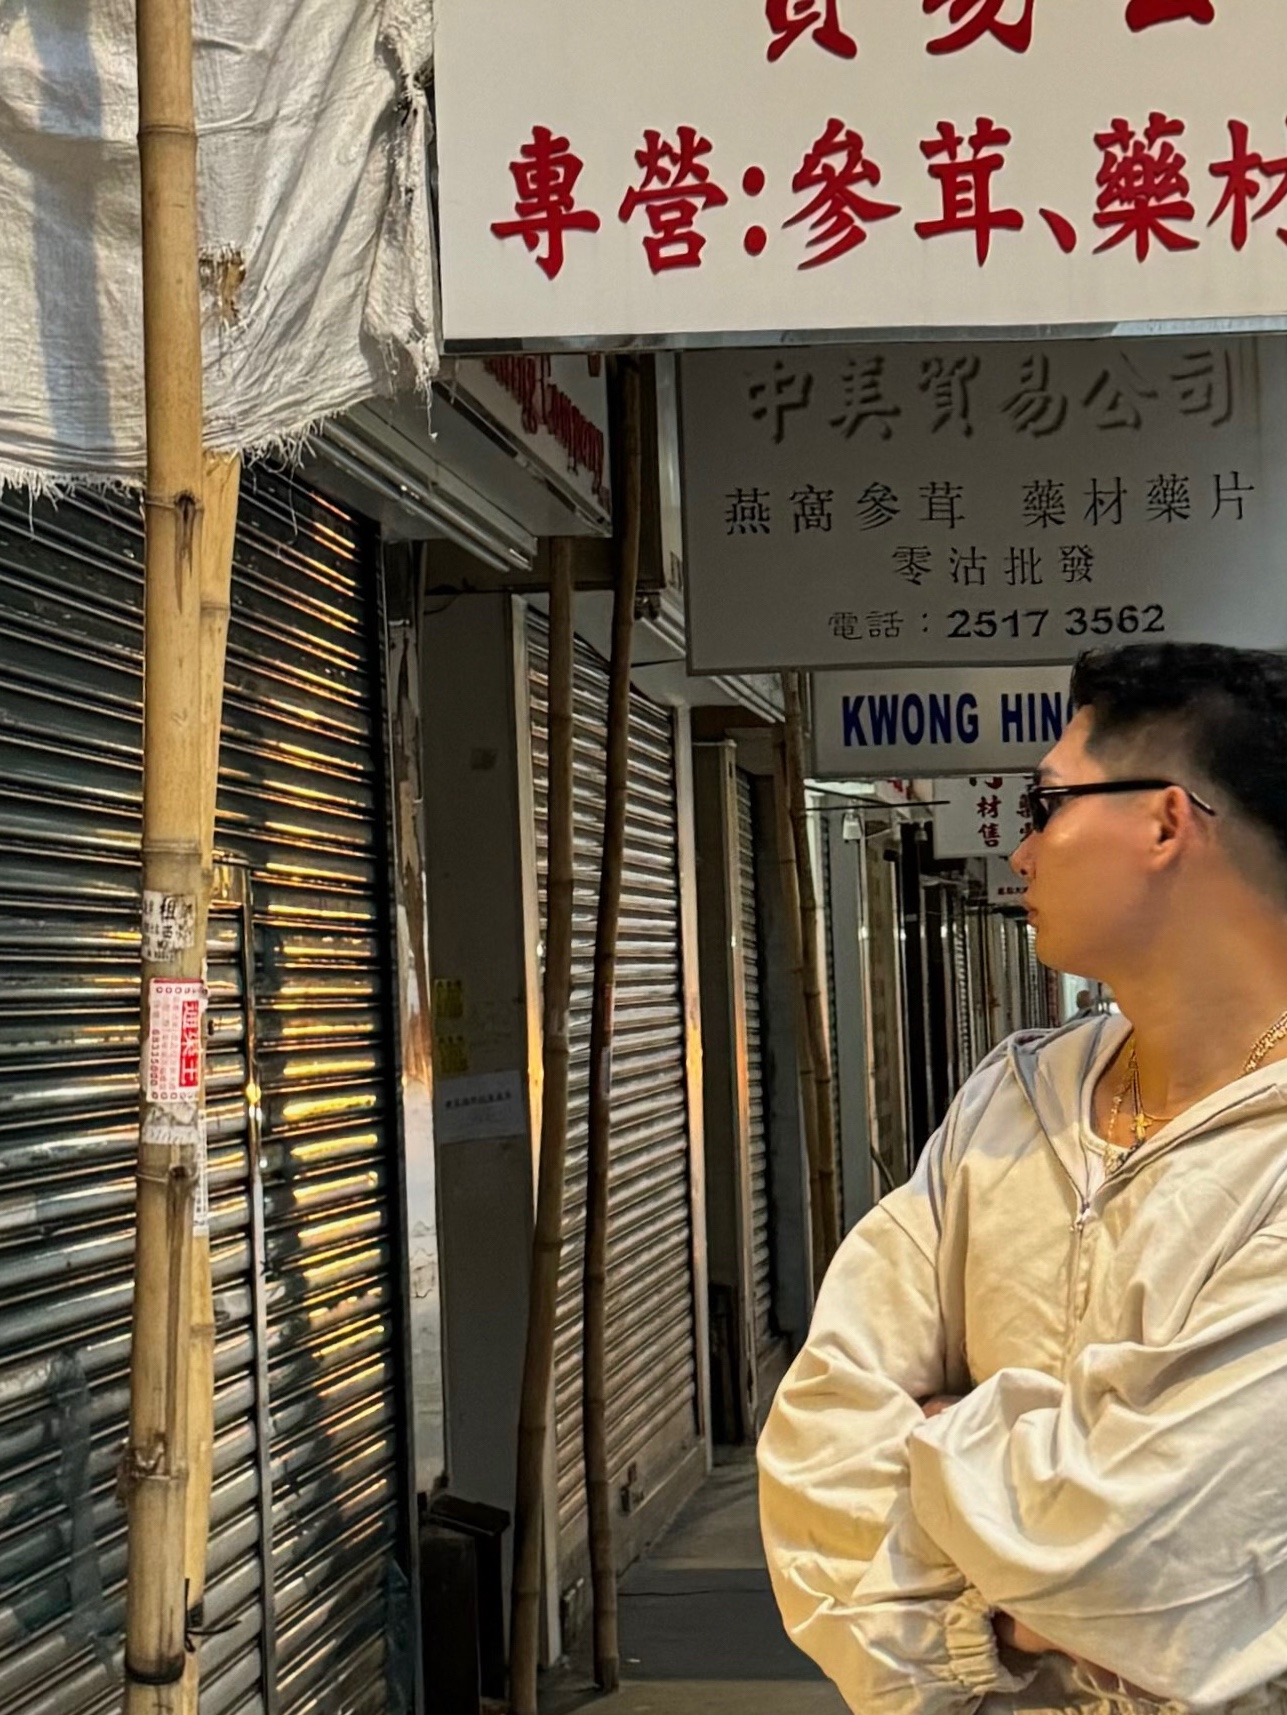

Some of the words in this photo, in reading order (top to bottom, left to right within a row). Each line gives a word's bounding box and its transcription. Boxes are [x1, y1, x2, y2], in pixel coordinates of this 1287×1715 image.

[723, 480, 967, 536] 燕窩參茸
[1021, 470, 1256, 530] 藥材藥片
[890, 543, 1096, 588] 零沽批發
[946, 607, 1048, 640] 2517
[1065, 603, 1166, 636] 3562
[842, 692, 980, 747] KWONG
